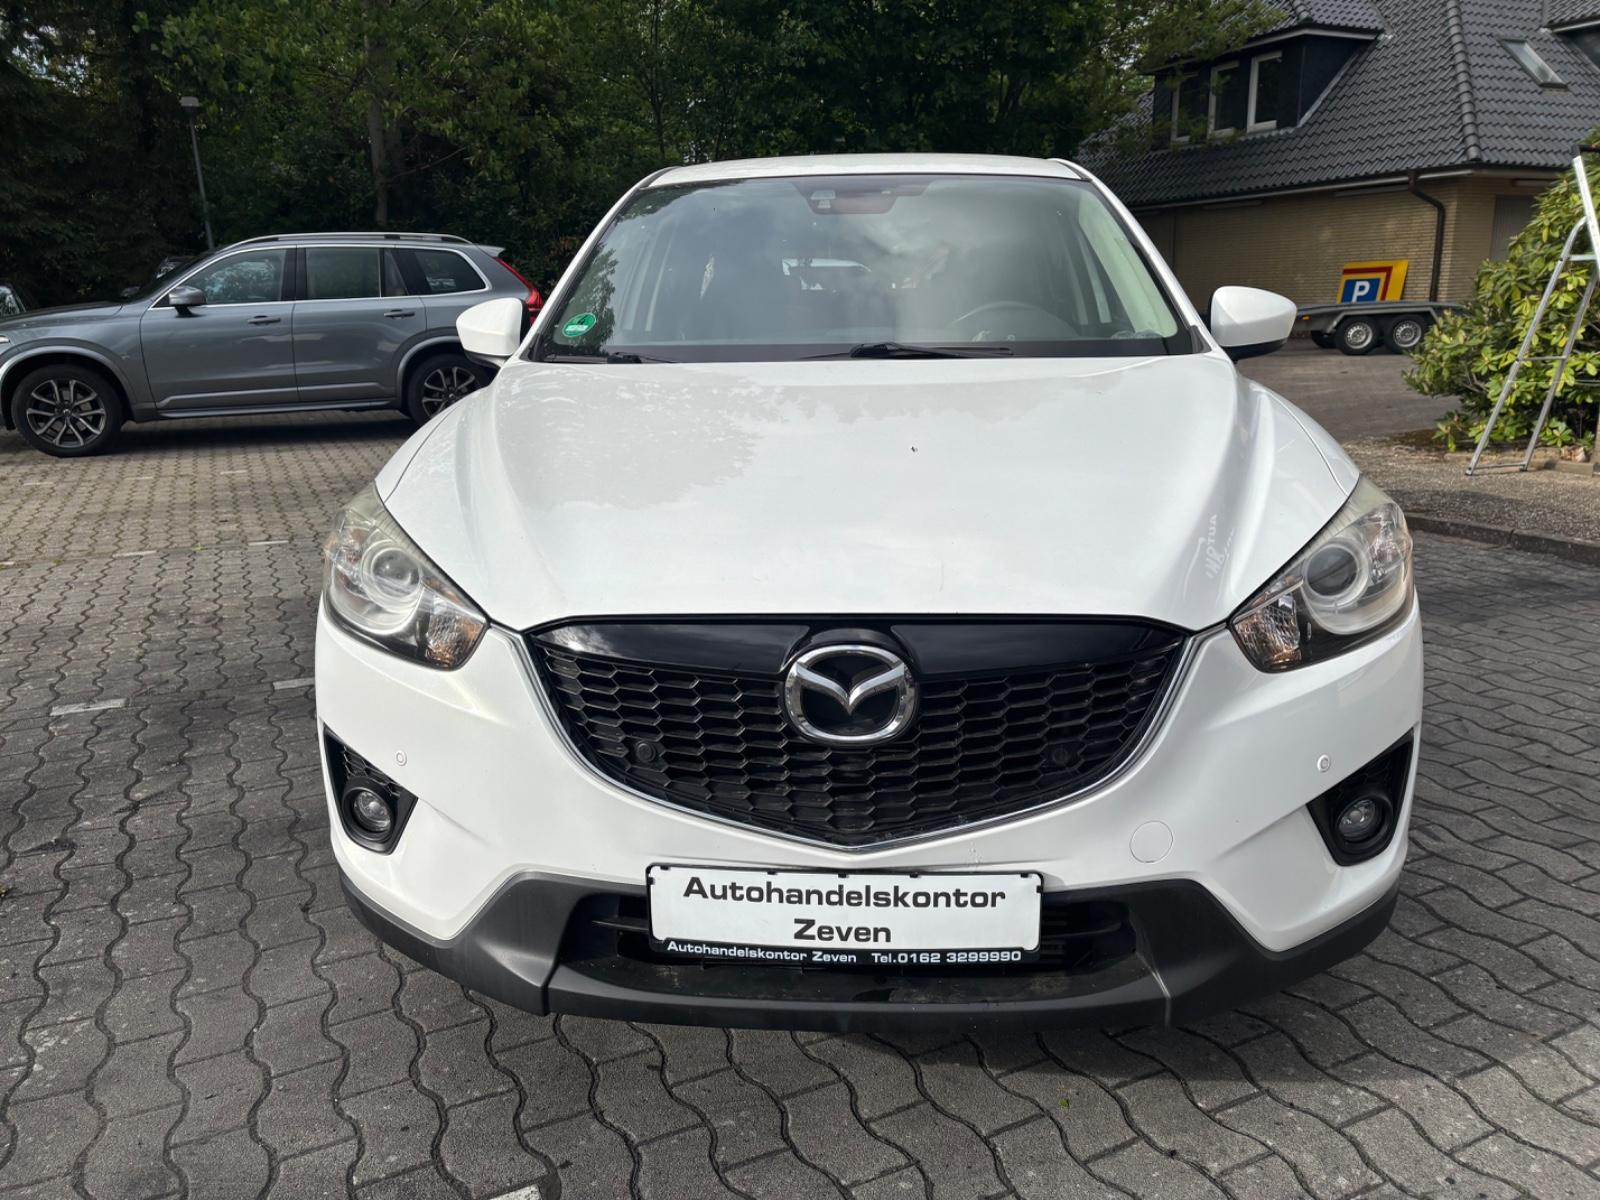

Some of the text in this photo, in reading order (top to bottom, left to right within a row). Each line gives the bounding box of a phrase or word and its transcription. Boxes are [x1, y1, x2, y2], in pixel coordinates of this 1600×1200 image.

[1351, 280, 1371, 304] P
[683, 876, 1006, 908] Autohandelskontor
[793, 918, 892, 943] Zeven
[666, 940, 1022, 964] Autohandelskontor Zeven Tel.0162 3299990
